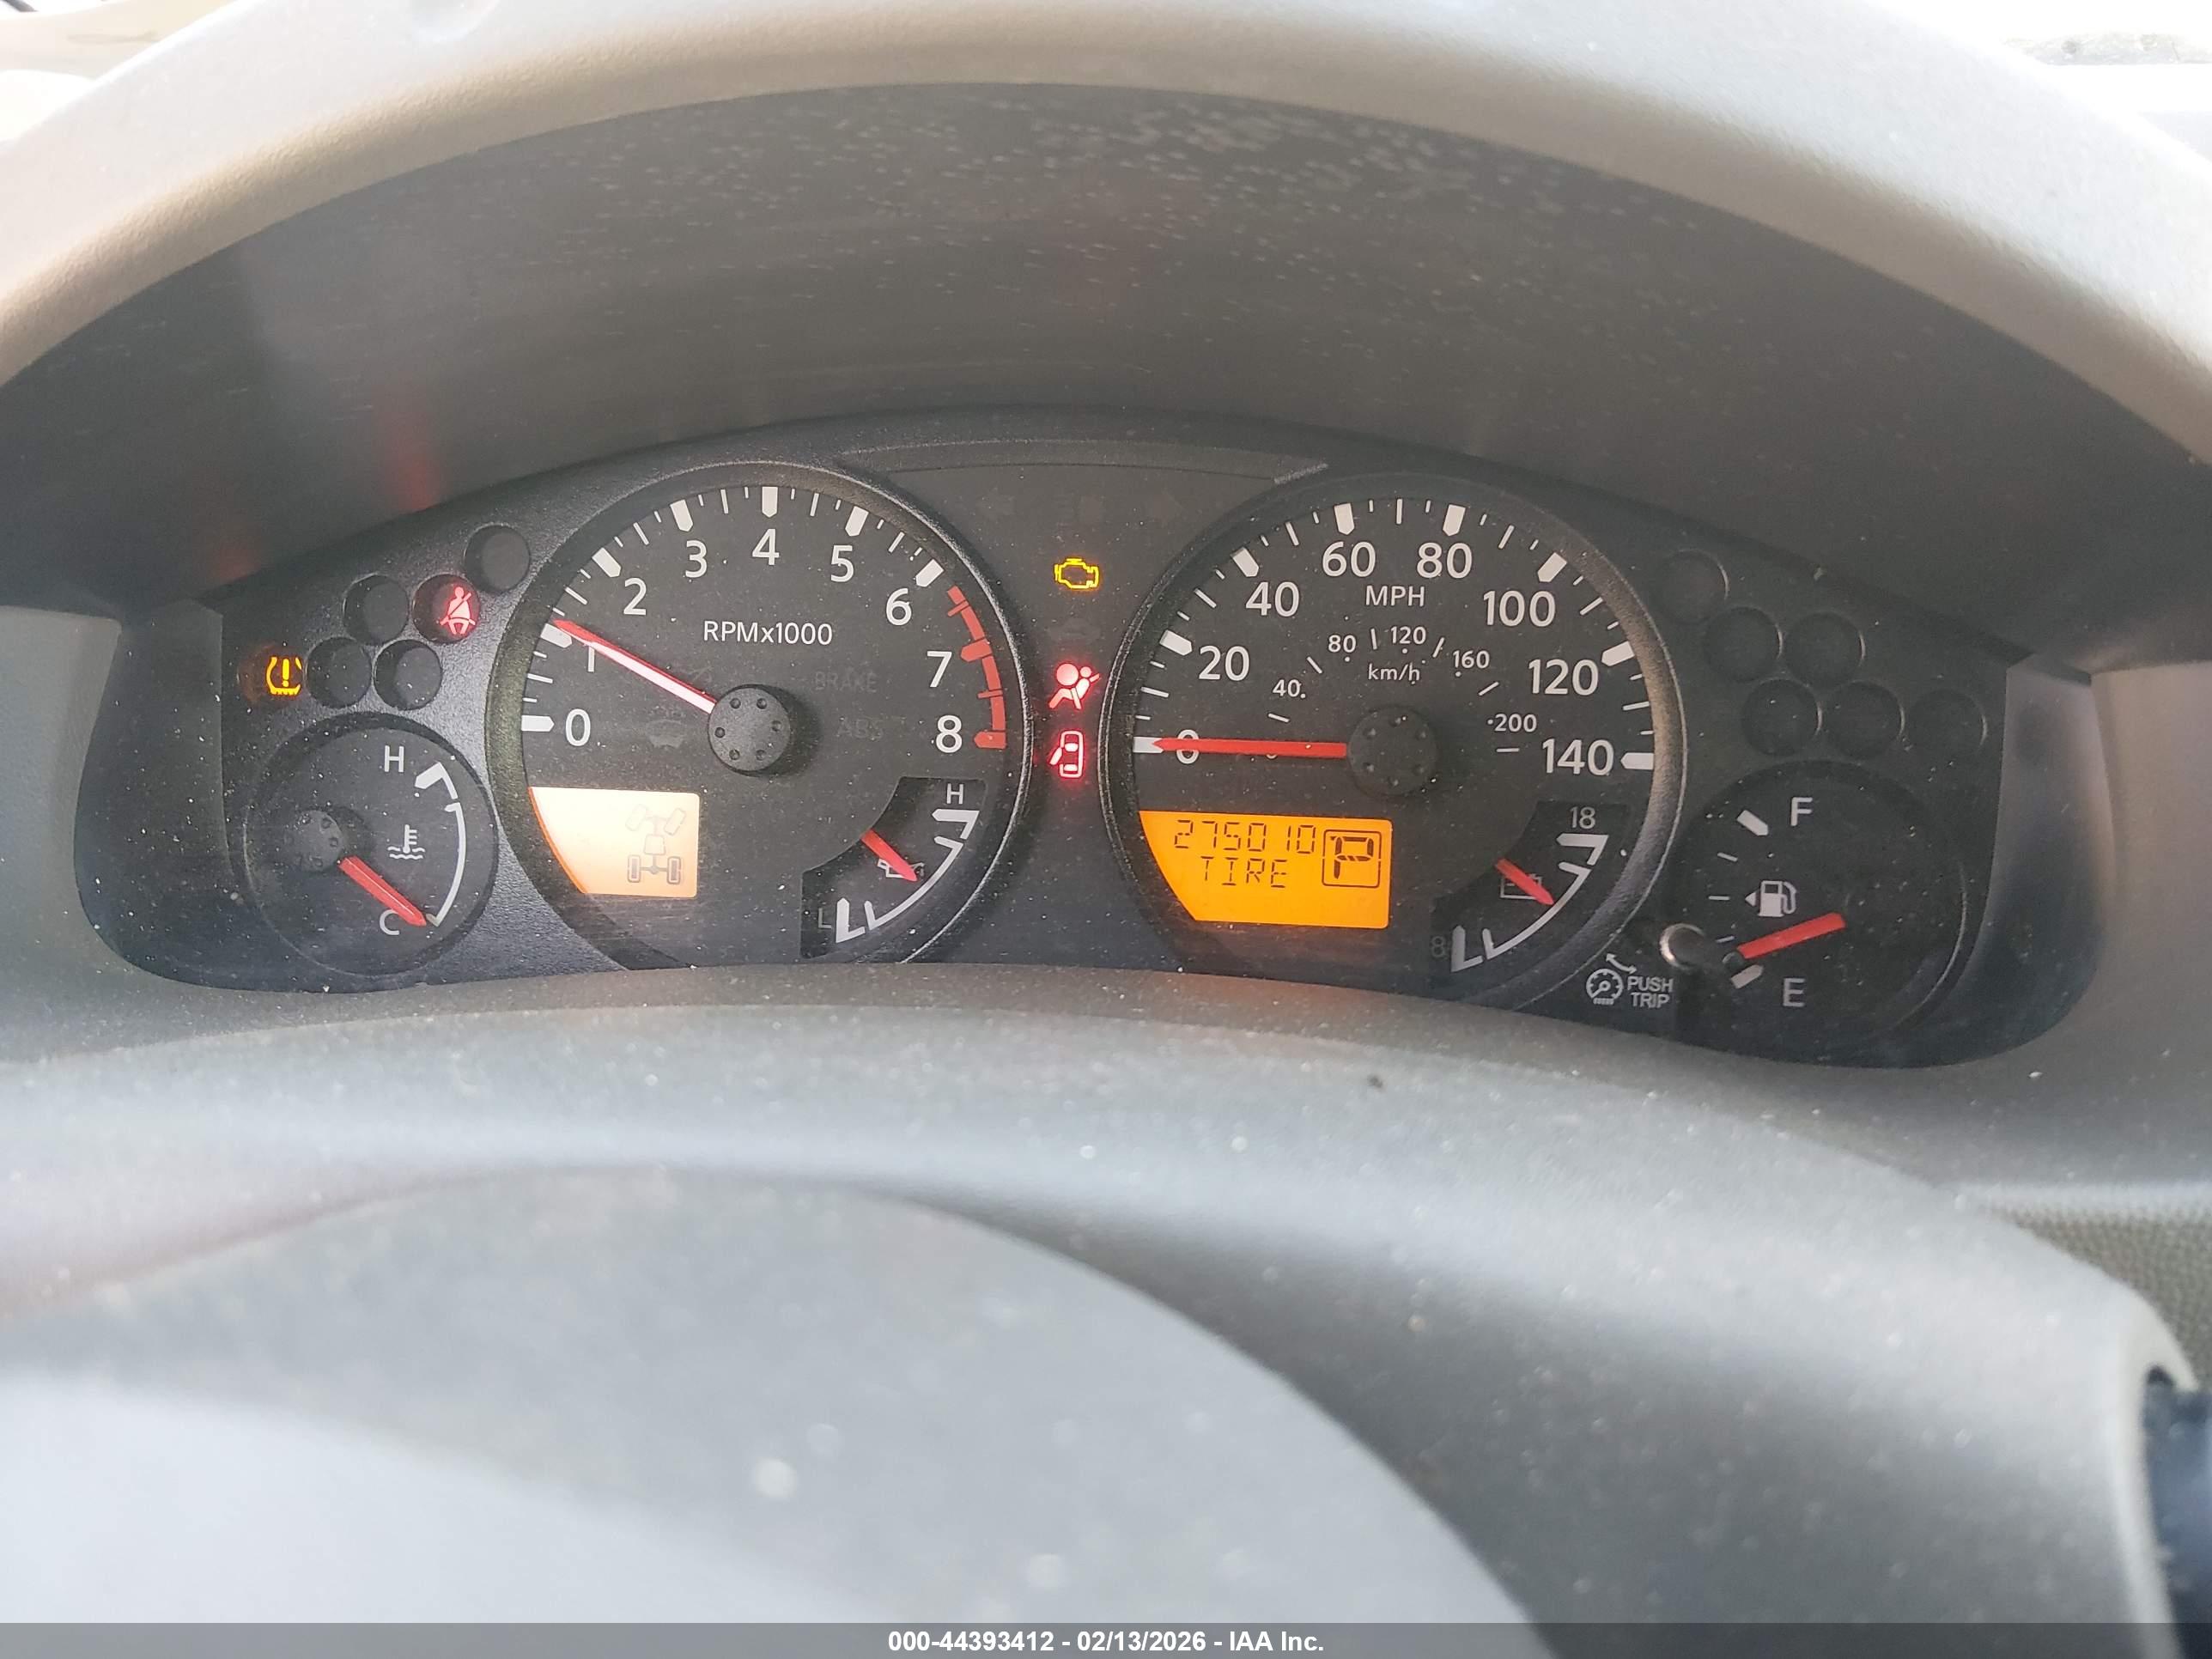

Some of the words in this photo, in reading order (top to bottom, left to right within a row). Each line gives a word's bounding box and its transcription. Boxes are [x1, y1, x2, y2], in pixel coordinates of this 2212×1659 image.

[685, 539, 708, 578] 3
[751, 528, 780, 566] 4
[1322, 541, 1376, 577] 60
[1417, 542, 1473, 579] 80
[830, 544, 854, 582] 5
[623, 577, 647, 616] 2
[885, 587, 912, 626] 6
[1245, 581, 1299, 617] 40
[1365, 585, 1425, 607] MPH
[1483, 590, 1556, 627] 100
[703, 620, 833, 646] RPMx1000
[1328, 635, 1357, 653] 80
[1390, 626, 1426, 645] 120
[927, 650, 952, 688] 7
[1199, 645, 1249, 681] 20
[1368, 662, 1420, 681] km/h
[1453, 650, 1490, 669] 160
[1273, 679, 1298, 697] 40
[1528, 659, 1599, 696] 120
[565, 708, 591, 746] 0
[935, 714, 963, 753] 8
[1494, 714, 1537, 732] 200
[384, 744, 404, 773] H
[1542, 738, 1614, 776] 140
[946, 783, 964, 805] H
[1571, 807, 1595, 830] 18
[1790, 797, 1813, 827] F
[1174, 819, 1316, 854] 275010
[1200, 856, 1288, 888] TIRE
[1330, 836, 1375, 879] P
[379, 908, 401, 936] C
[817, 908, 833, 930] L
[1431, 935, 1445, 957] 8
[1627, 975, 1674, 993] PUSH
[1783, 977, 1805, 1007] E
[1631, 993, 1671, 1008] TRIP
